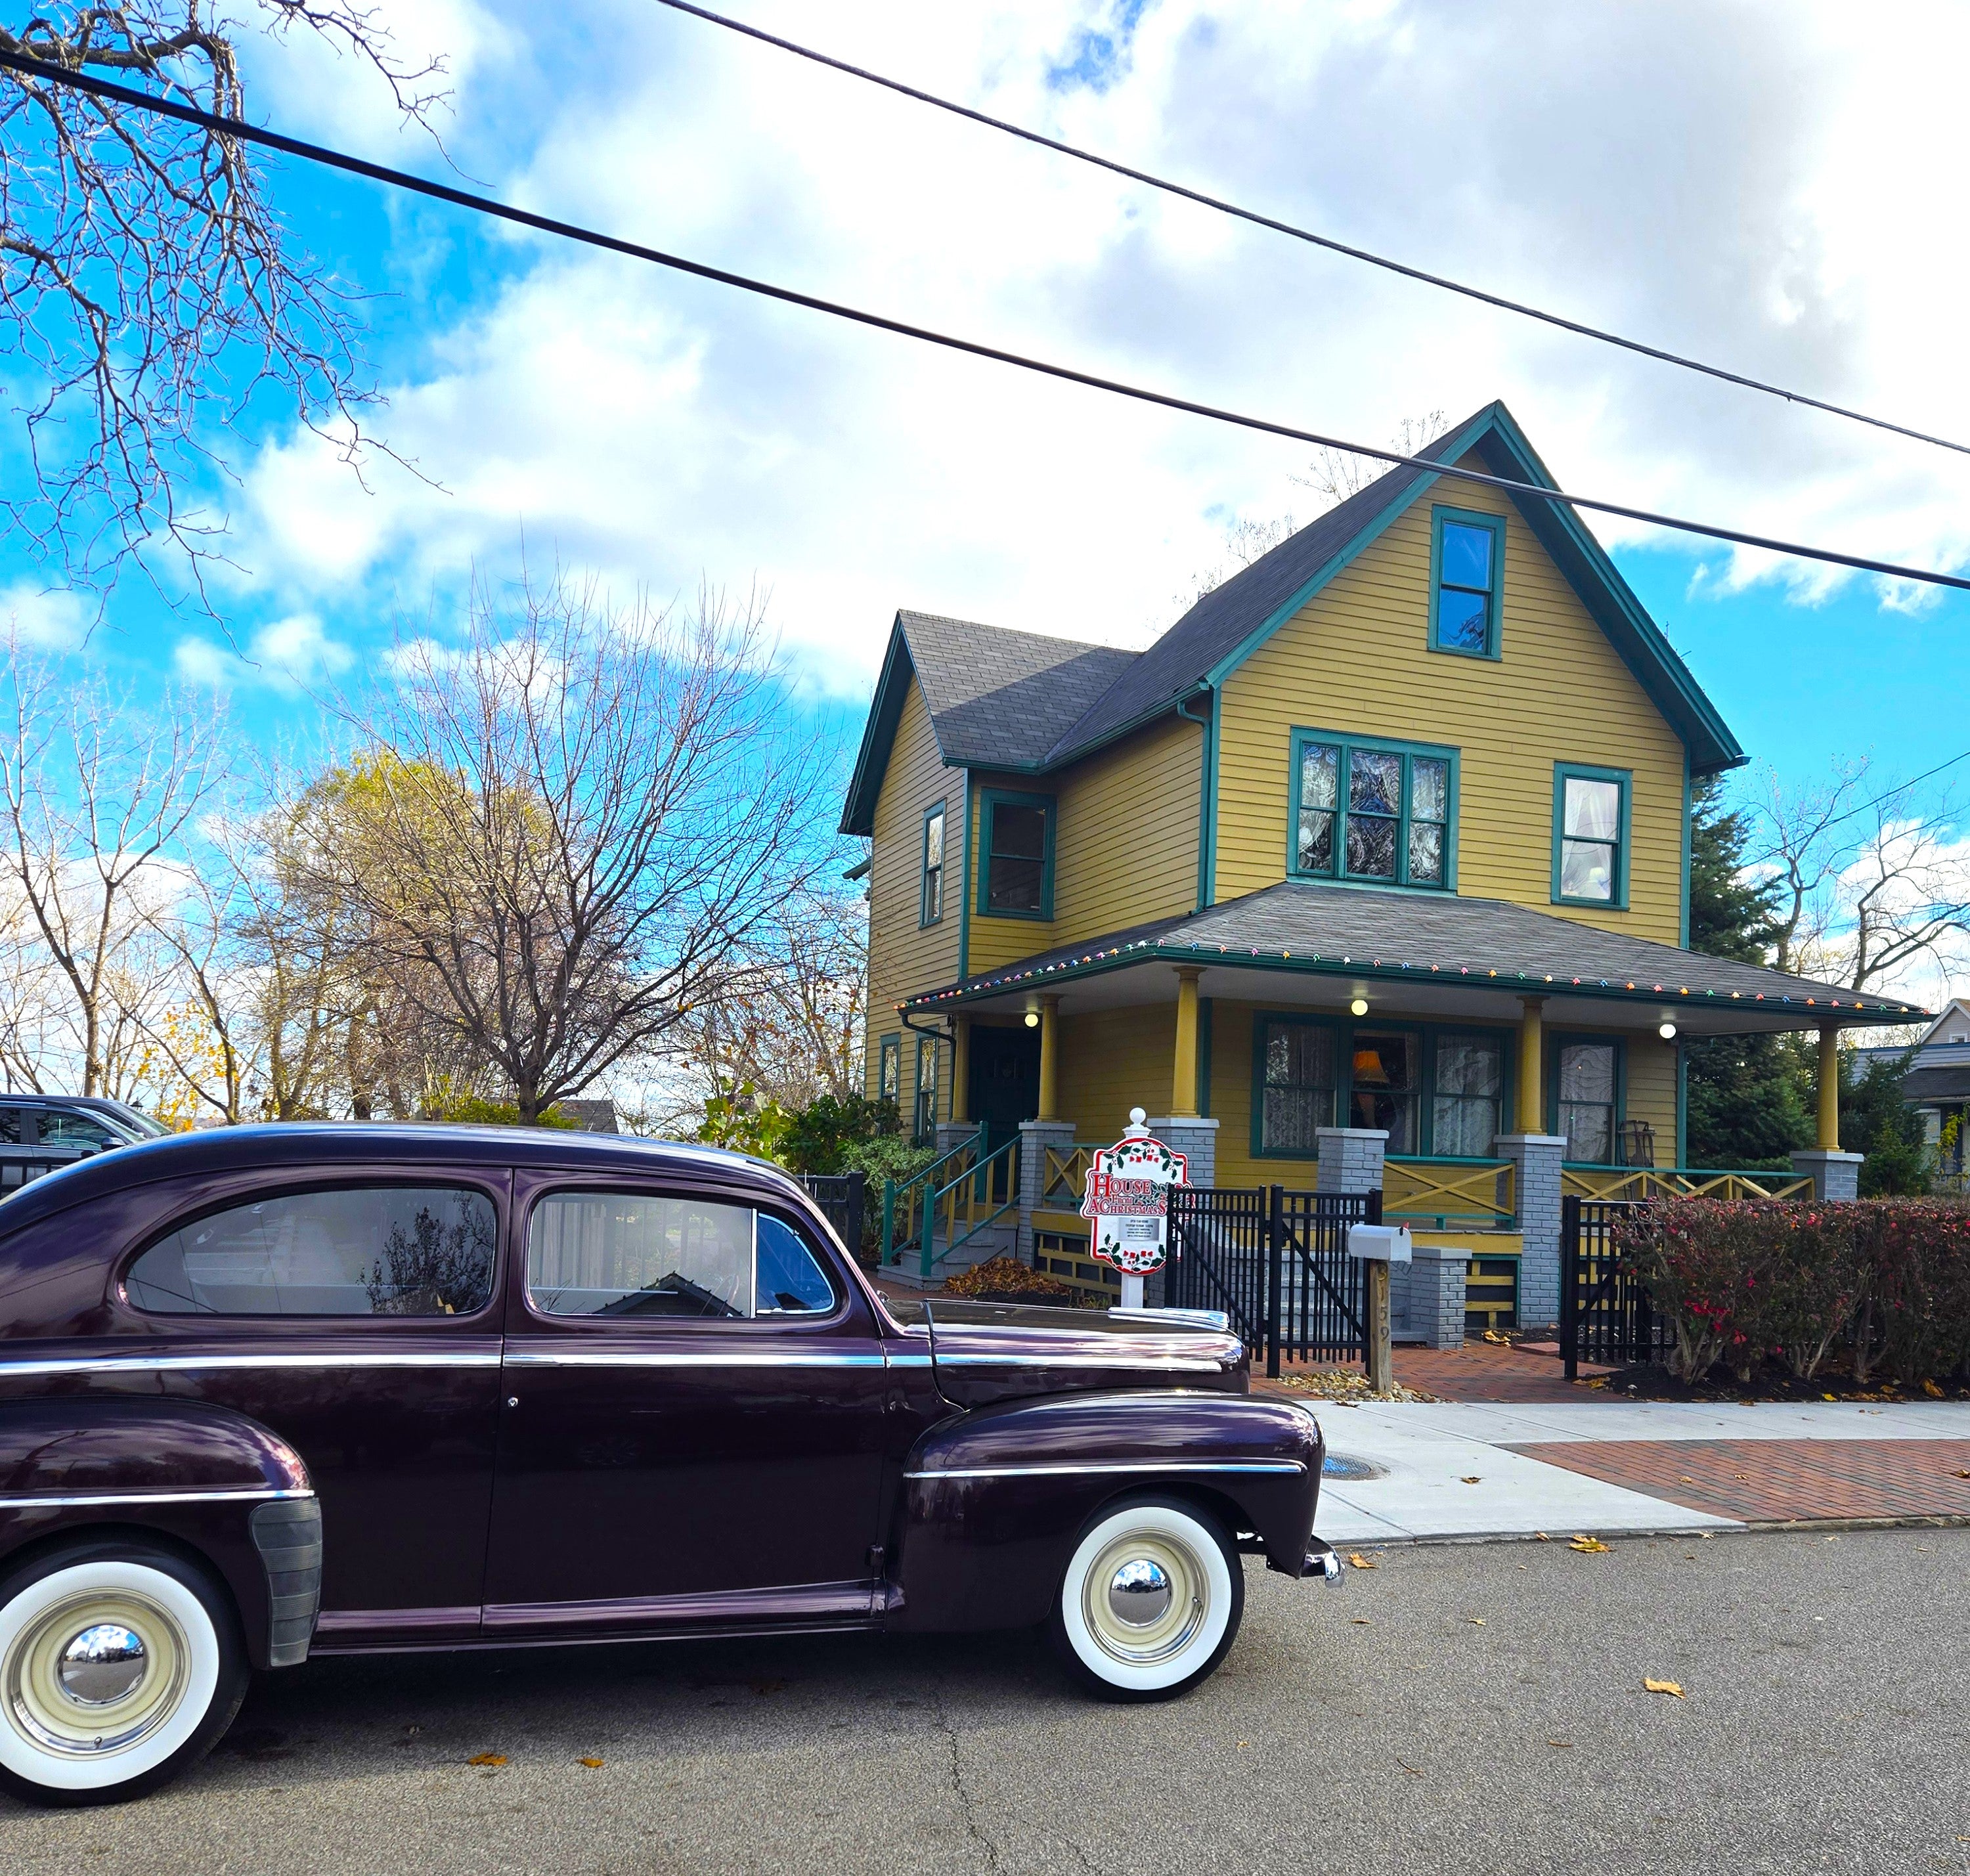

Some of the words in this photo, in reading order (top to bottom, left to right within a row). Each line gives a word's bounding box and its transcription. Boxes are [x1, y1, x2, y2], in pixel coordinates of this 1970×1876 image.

[1092, 1173, 1150, 1197] HOUSE
[1099, 1198, 1158, 1214] CHRISTMAS
[1112, 1194, 1132, 1204] FROM
